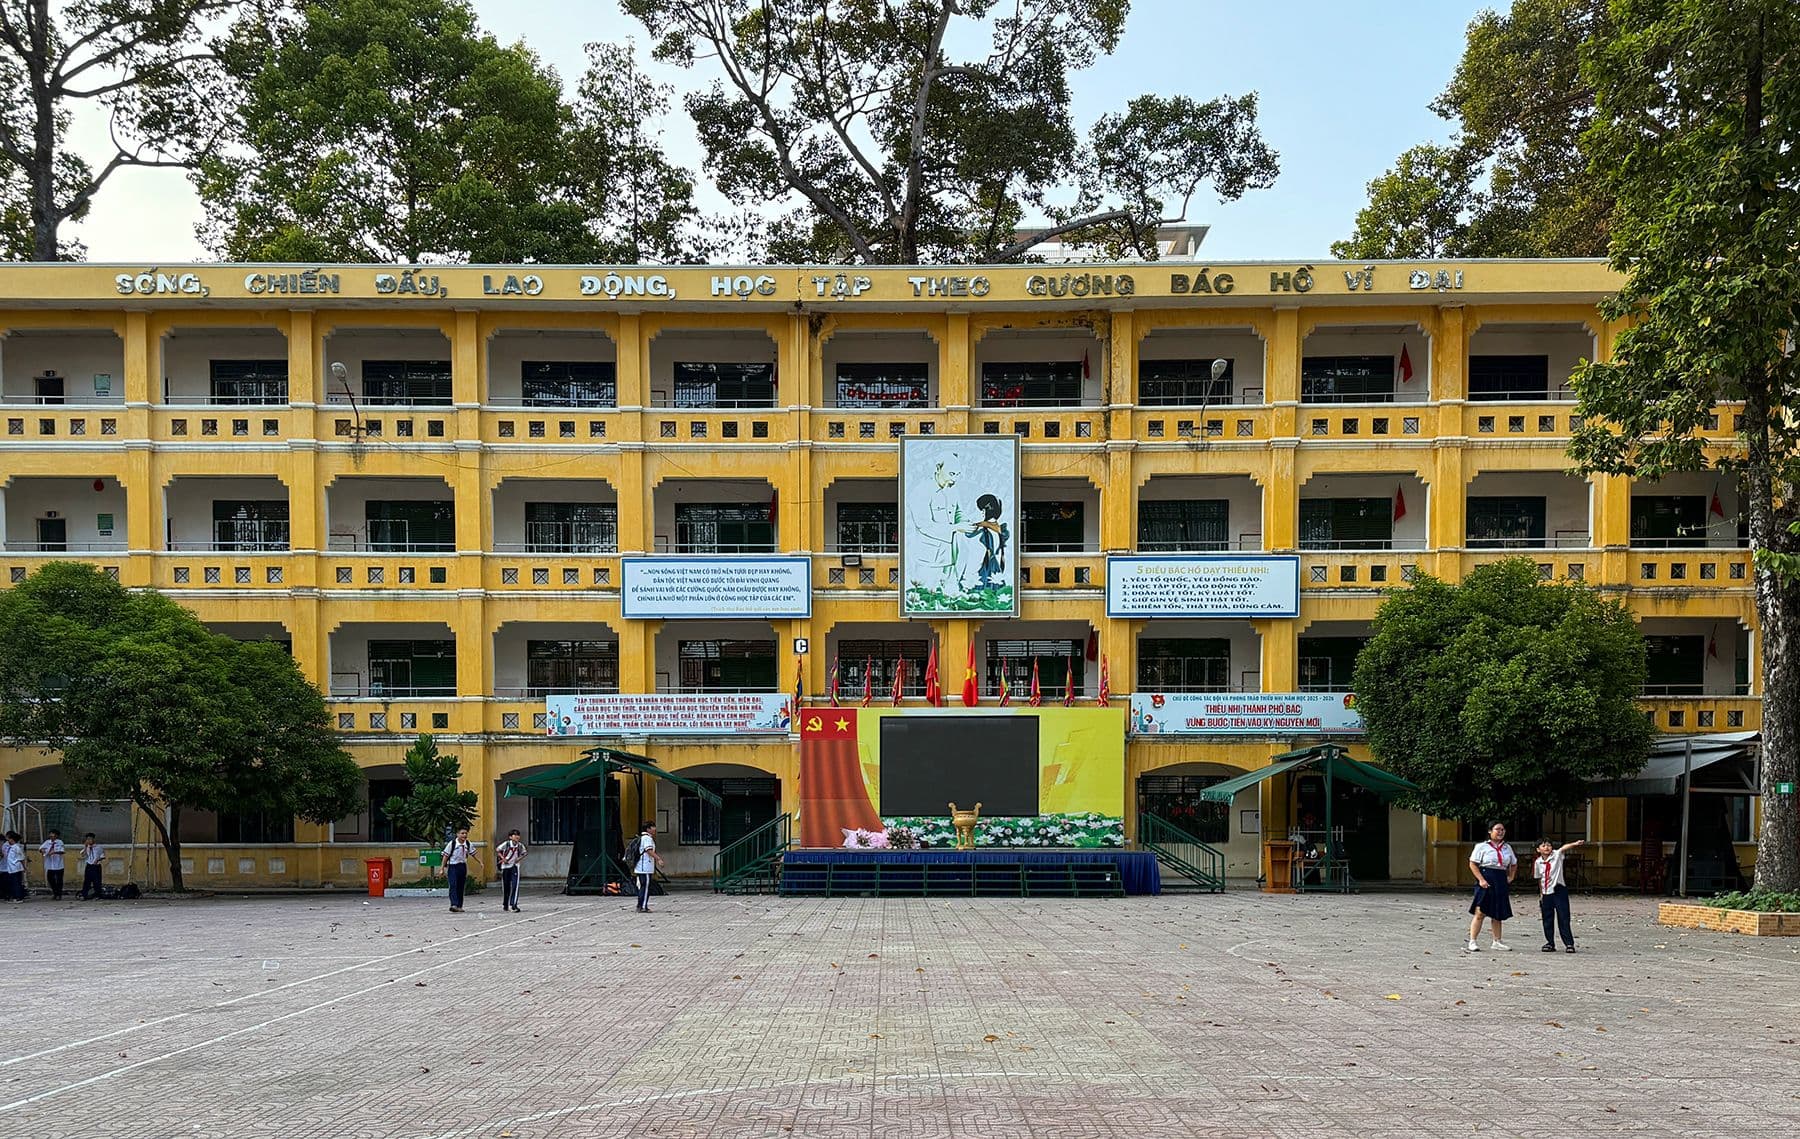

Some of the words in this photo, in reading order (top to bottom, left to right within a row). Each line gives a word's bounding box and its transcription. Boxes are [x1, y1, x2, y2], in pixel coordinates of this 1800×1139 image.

[113, 266, 211, 297] SỐNG,
[243, 267, 341, 294] CHIẾN
[374, 268, 449, 298] ĐẤU,
[482, 275, 545, 296] LAO
[579, 272, 678, 300] ĐỘNG,
[710, 275, 778, 300] HỌC
[810, 272, 873, 300] TẬP
[907, 275, 992, 297] THEO
[1025, 273, 1136, 295] GƯƠNG
[1170, 268, 1235, 293] BÁC
[1269, 265, 1315, 292] HỒ
[1408, 269, 1464, 292] ĐẠI
[1136, 565, 1144, 574] 5
[1145, 566, 1167, 574] ĐIỀU
[1168, 566, 1186, 574] BÁC
[1187, 566, 1202, 574] HỒ
[1202, 566, 1221, 574] DẠY
[1222, 566, 1249, 574] THIẾU
[1250, 566, 1270, 574] NHI:
[795, 640, 807, 652] C
